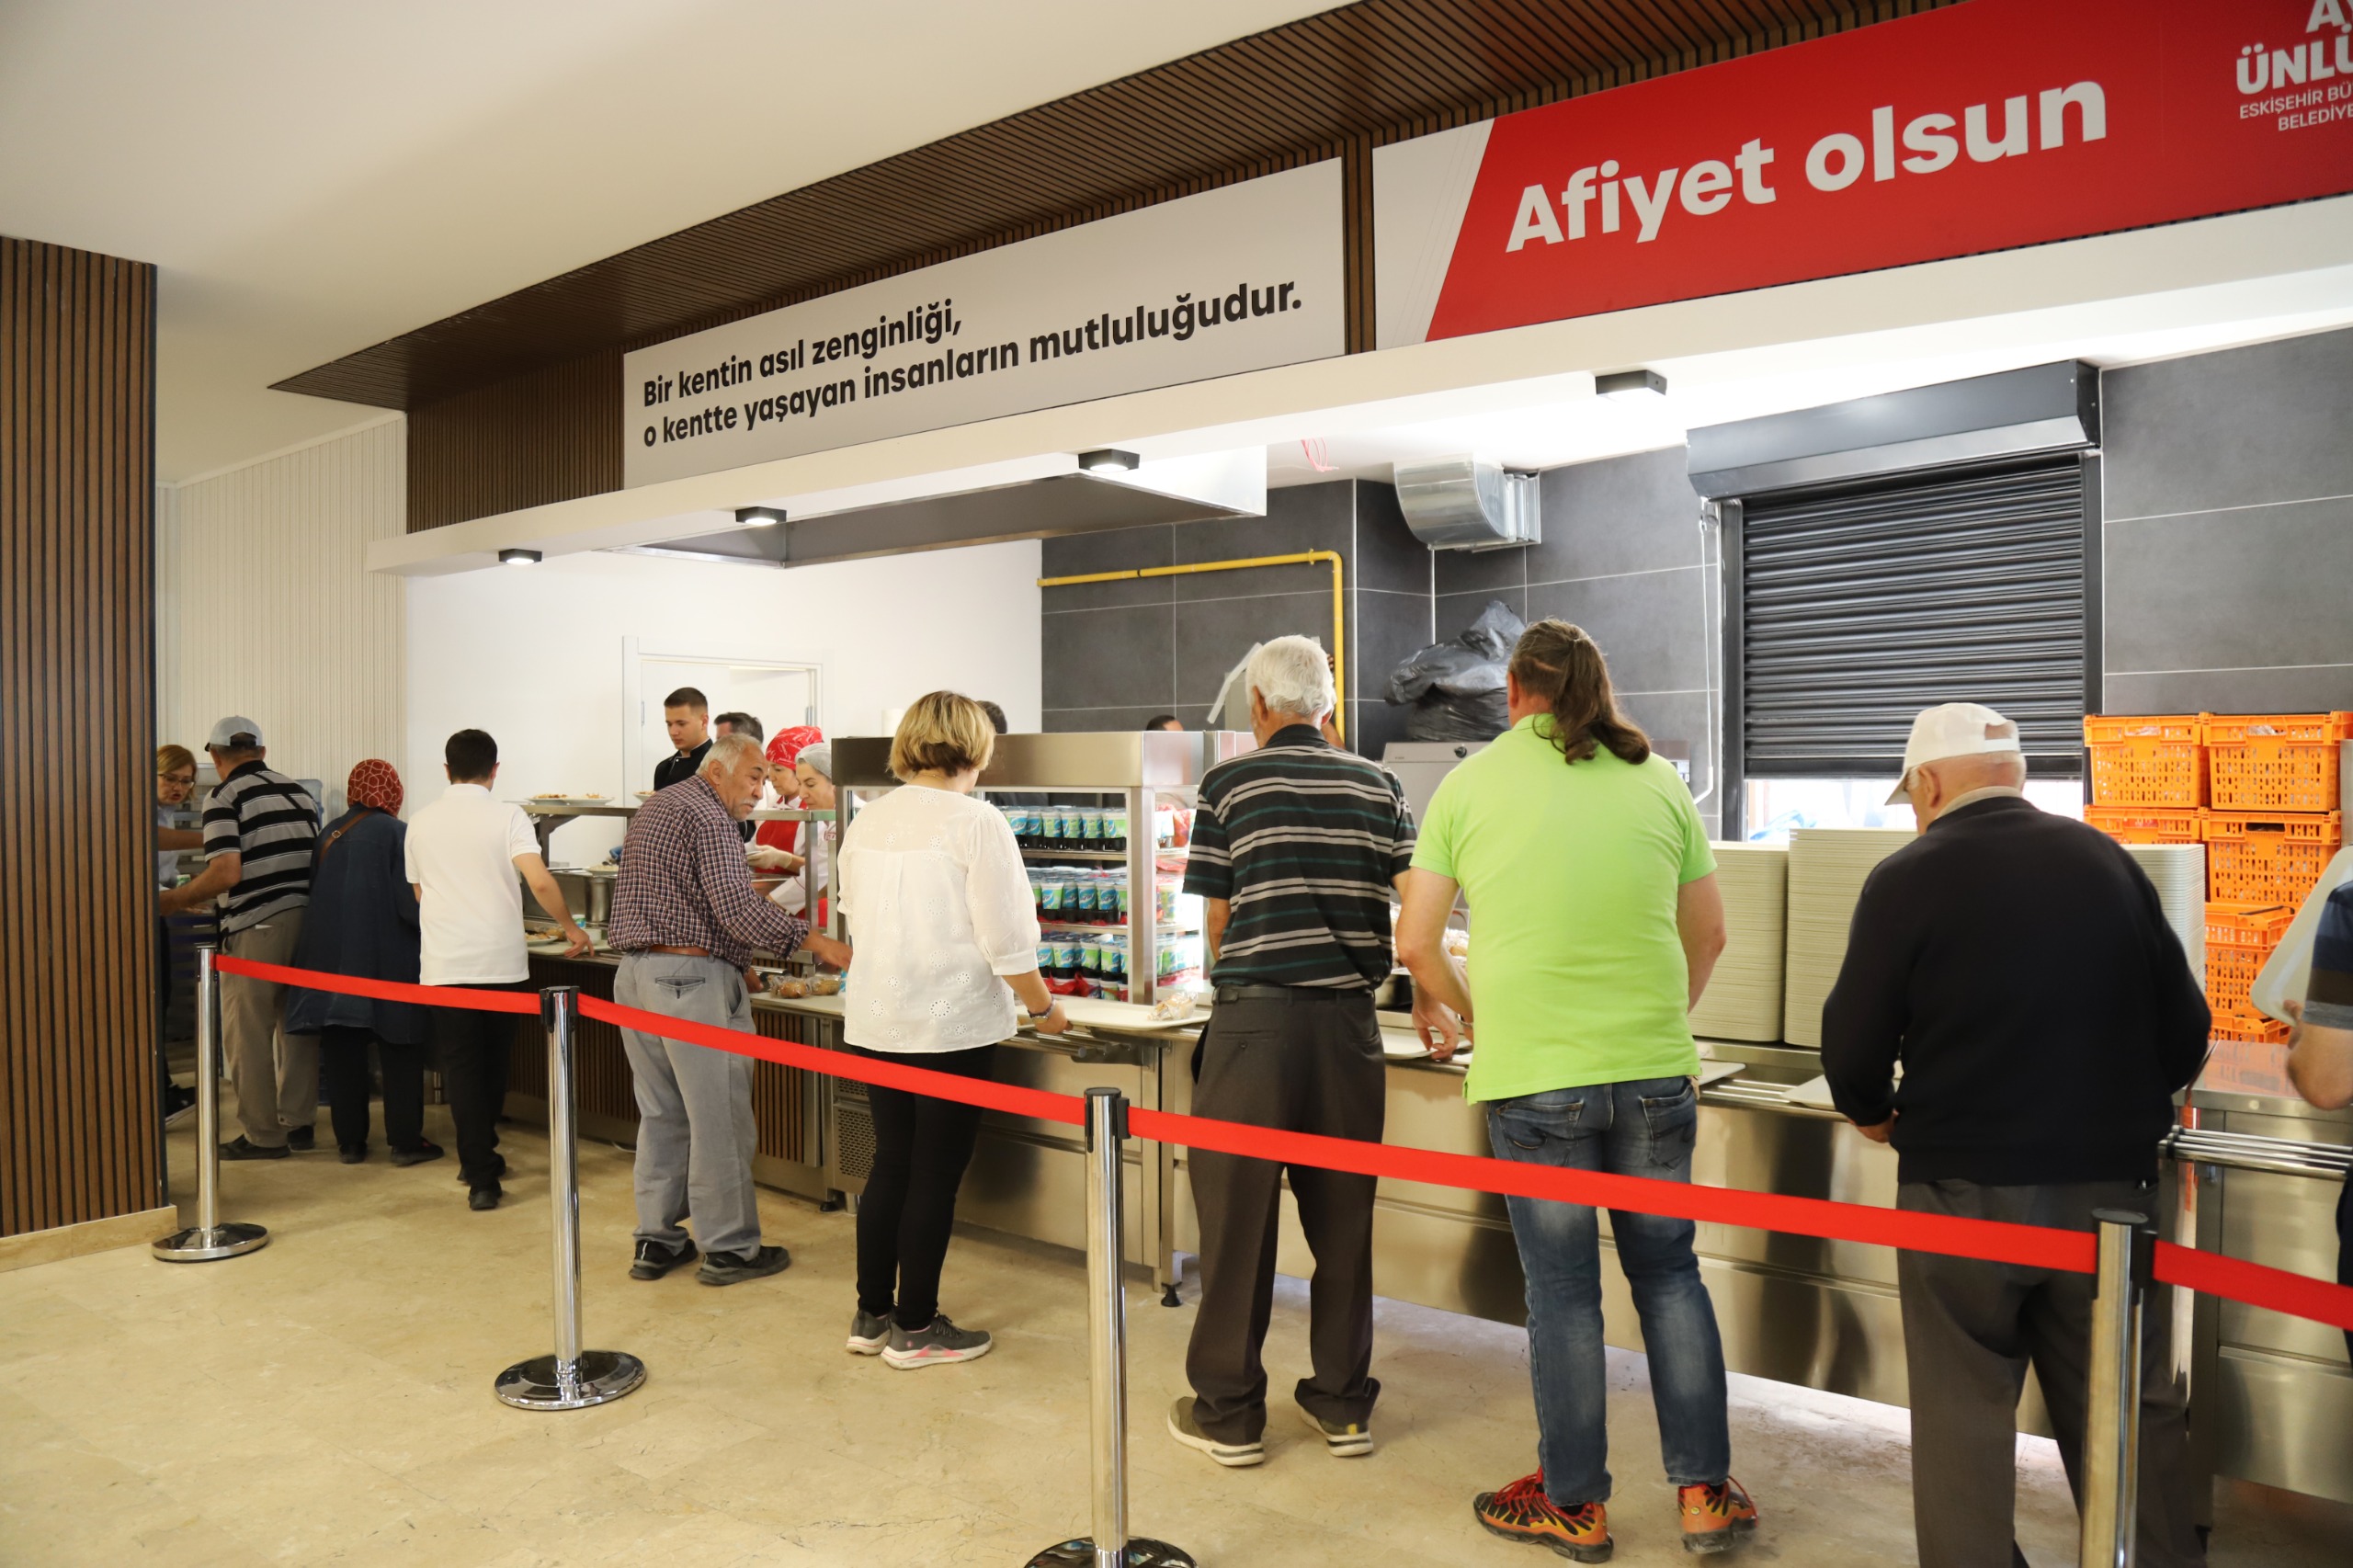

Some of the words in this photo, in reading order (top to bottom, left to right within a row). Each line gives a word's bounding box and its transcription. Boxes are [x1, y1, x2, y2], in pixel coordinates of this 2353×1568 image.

[2239, 89, 2324, 119] ESKİŞEHİR
[2327, 81, 2353, 102] BÜ
[2278, 103, 2353, 131] BELEDİYE
[1506, 138, 1777, 253] Afiyet
[1805, 81, 2108, 192] olsun
[643, 374, 674, 408] Bir
[678, 354, 753, 399] kentin
[759, 338, 804, 378] asıl
[812, 298, 962, 366] zenginliği,
[643, 426, 657, 448] o
[663, 405, 738, 444] kentte
[744, 379, 856, 432] yaşayan
[864, 341, 1019, 406] insanların
[1029, 280, 1302, 363] mutluluğudur.
